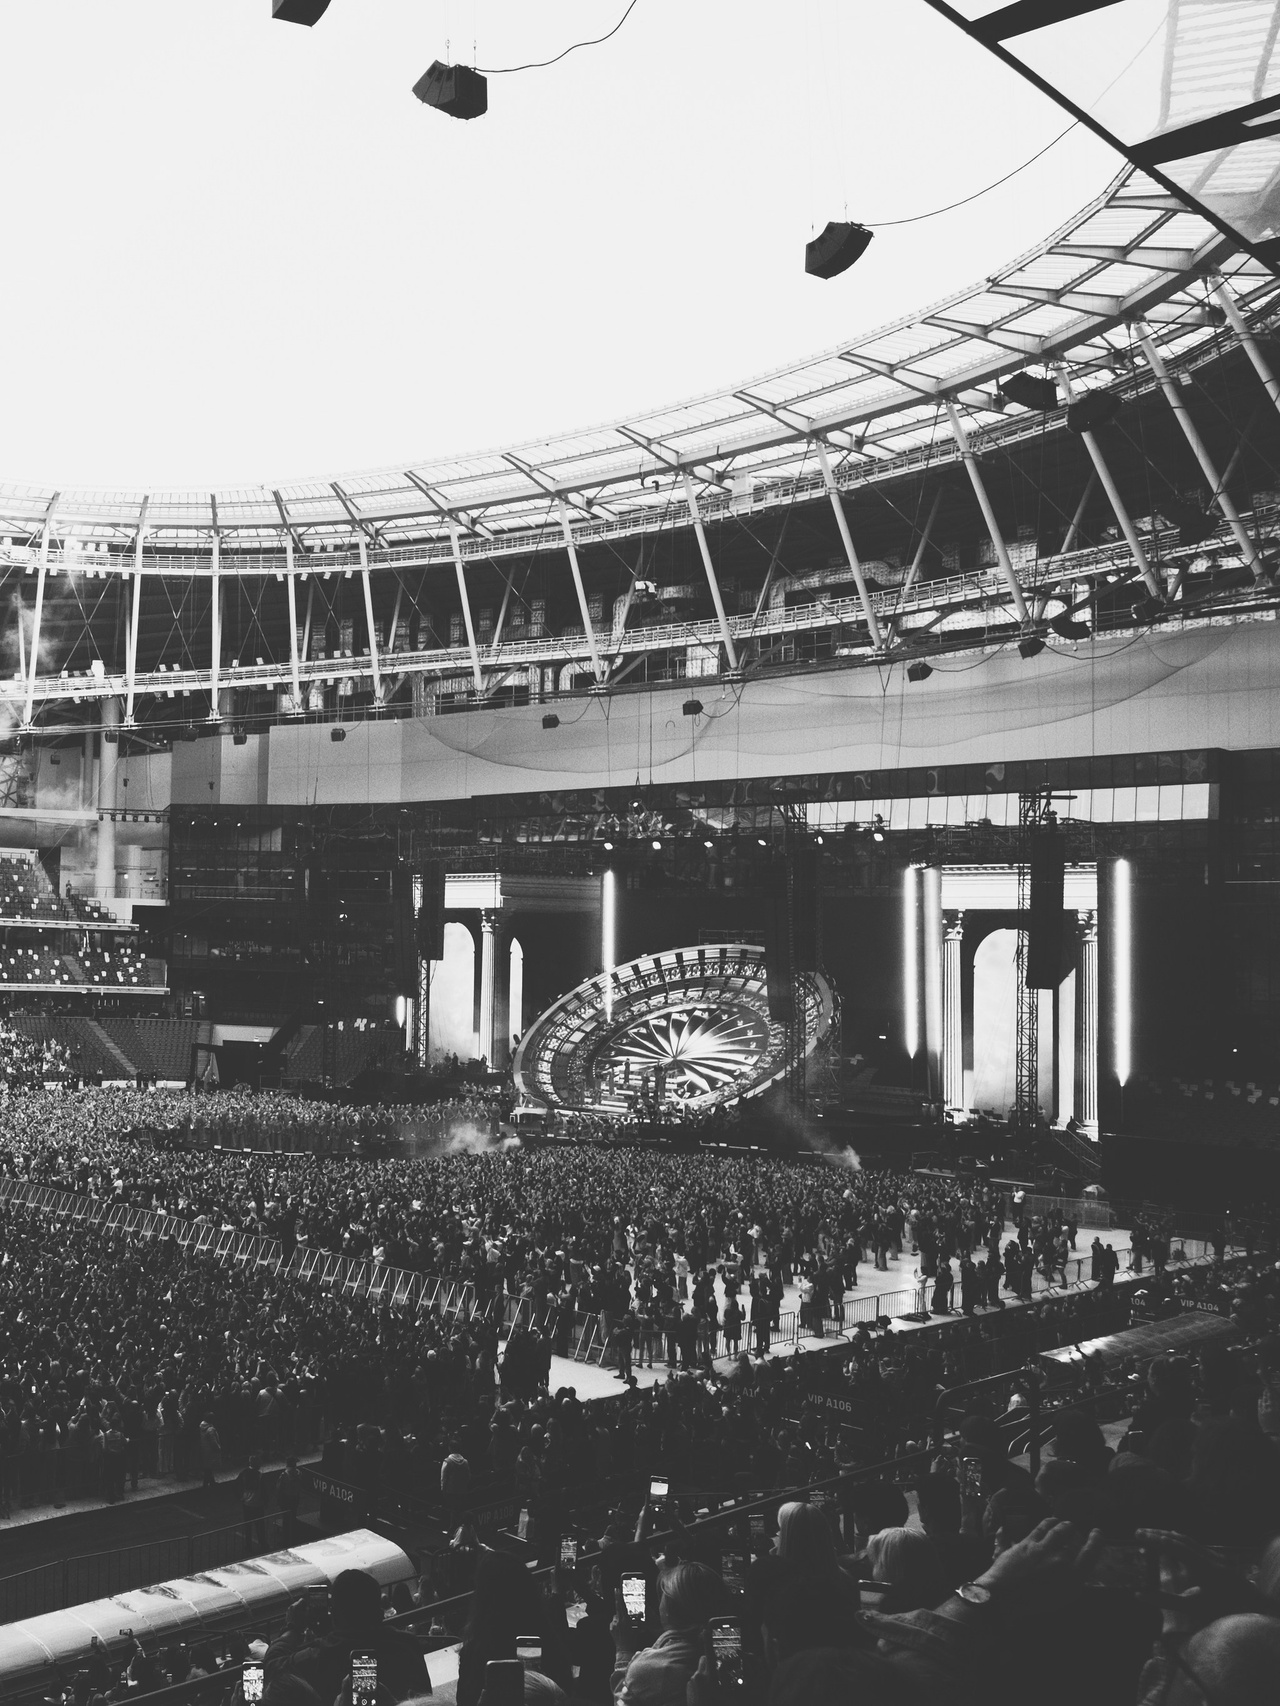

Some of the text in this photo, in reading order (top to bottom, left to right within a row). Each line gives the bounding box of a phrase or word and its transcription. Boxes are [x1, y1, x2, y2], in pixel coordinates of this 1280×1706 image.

[1180, 1298, 1219, 1312] VIP A104
[807, 1392, 824, 1405] VIP
[826, 1397, 852, 1412] A106
[312, 1477, 354, 1503] VIP A108
[478, 1511, 492, 1526] VIP
